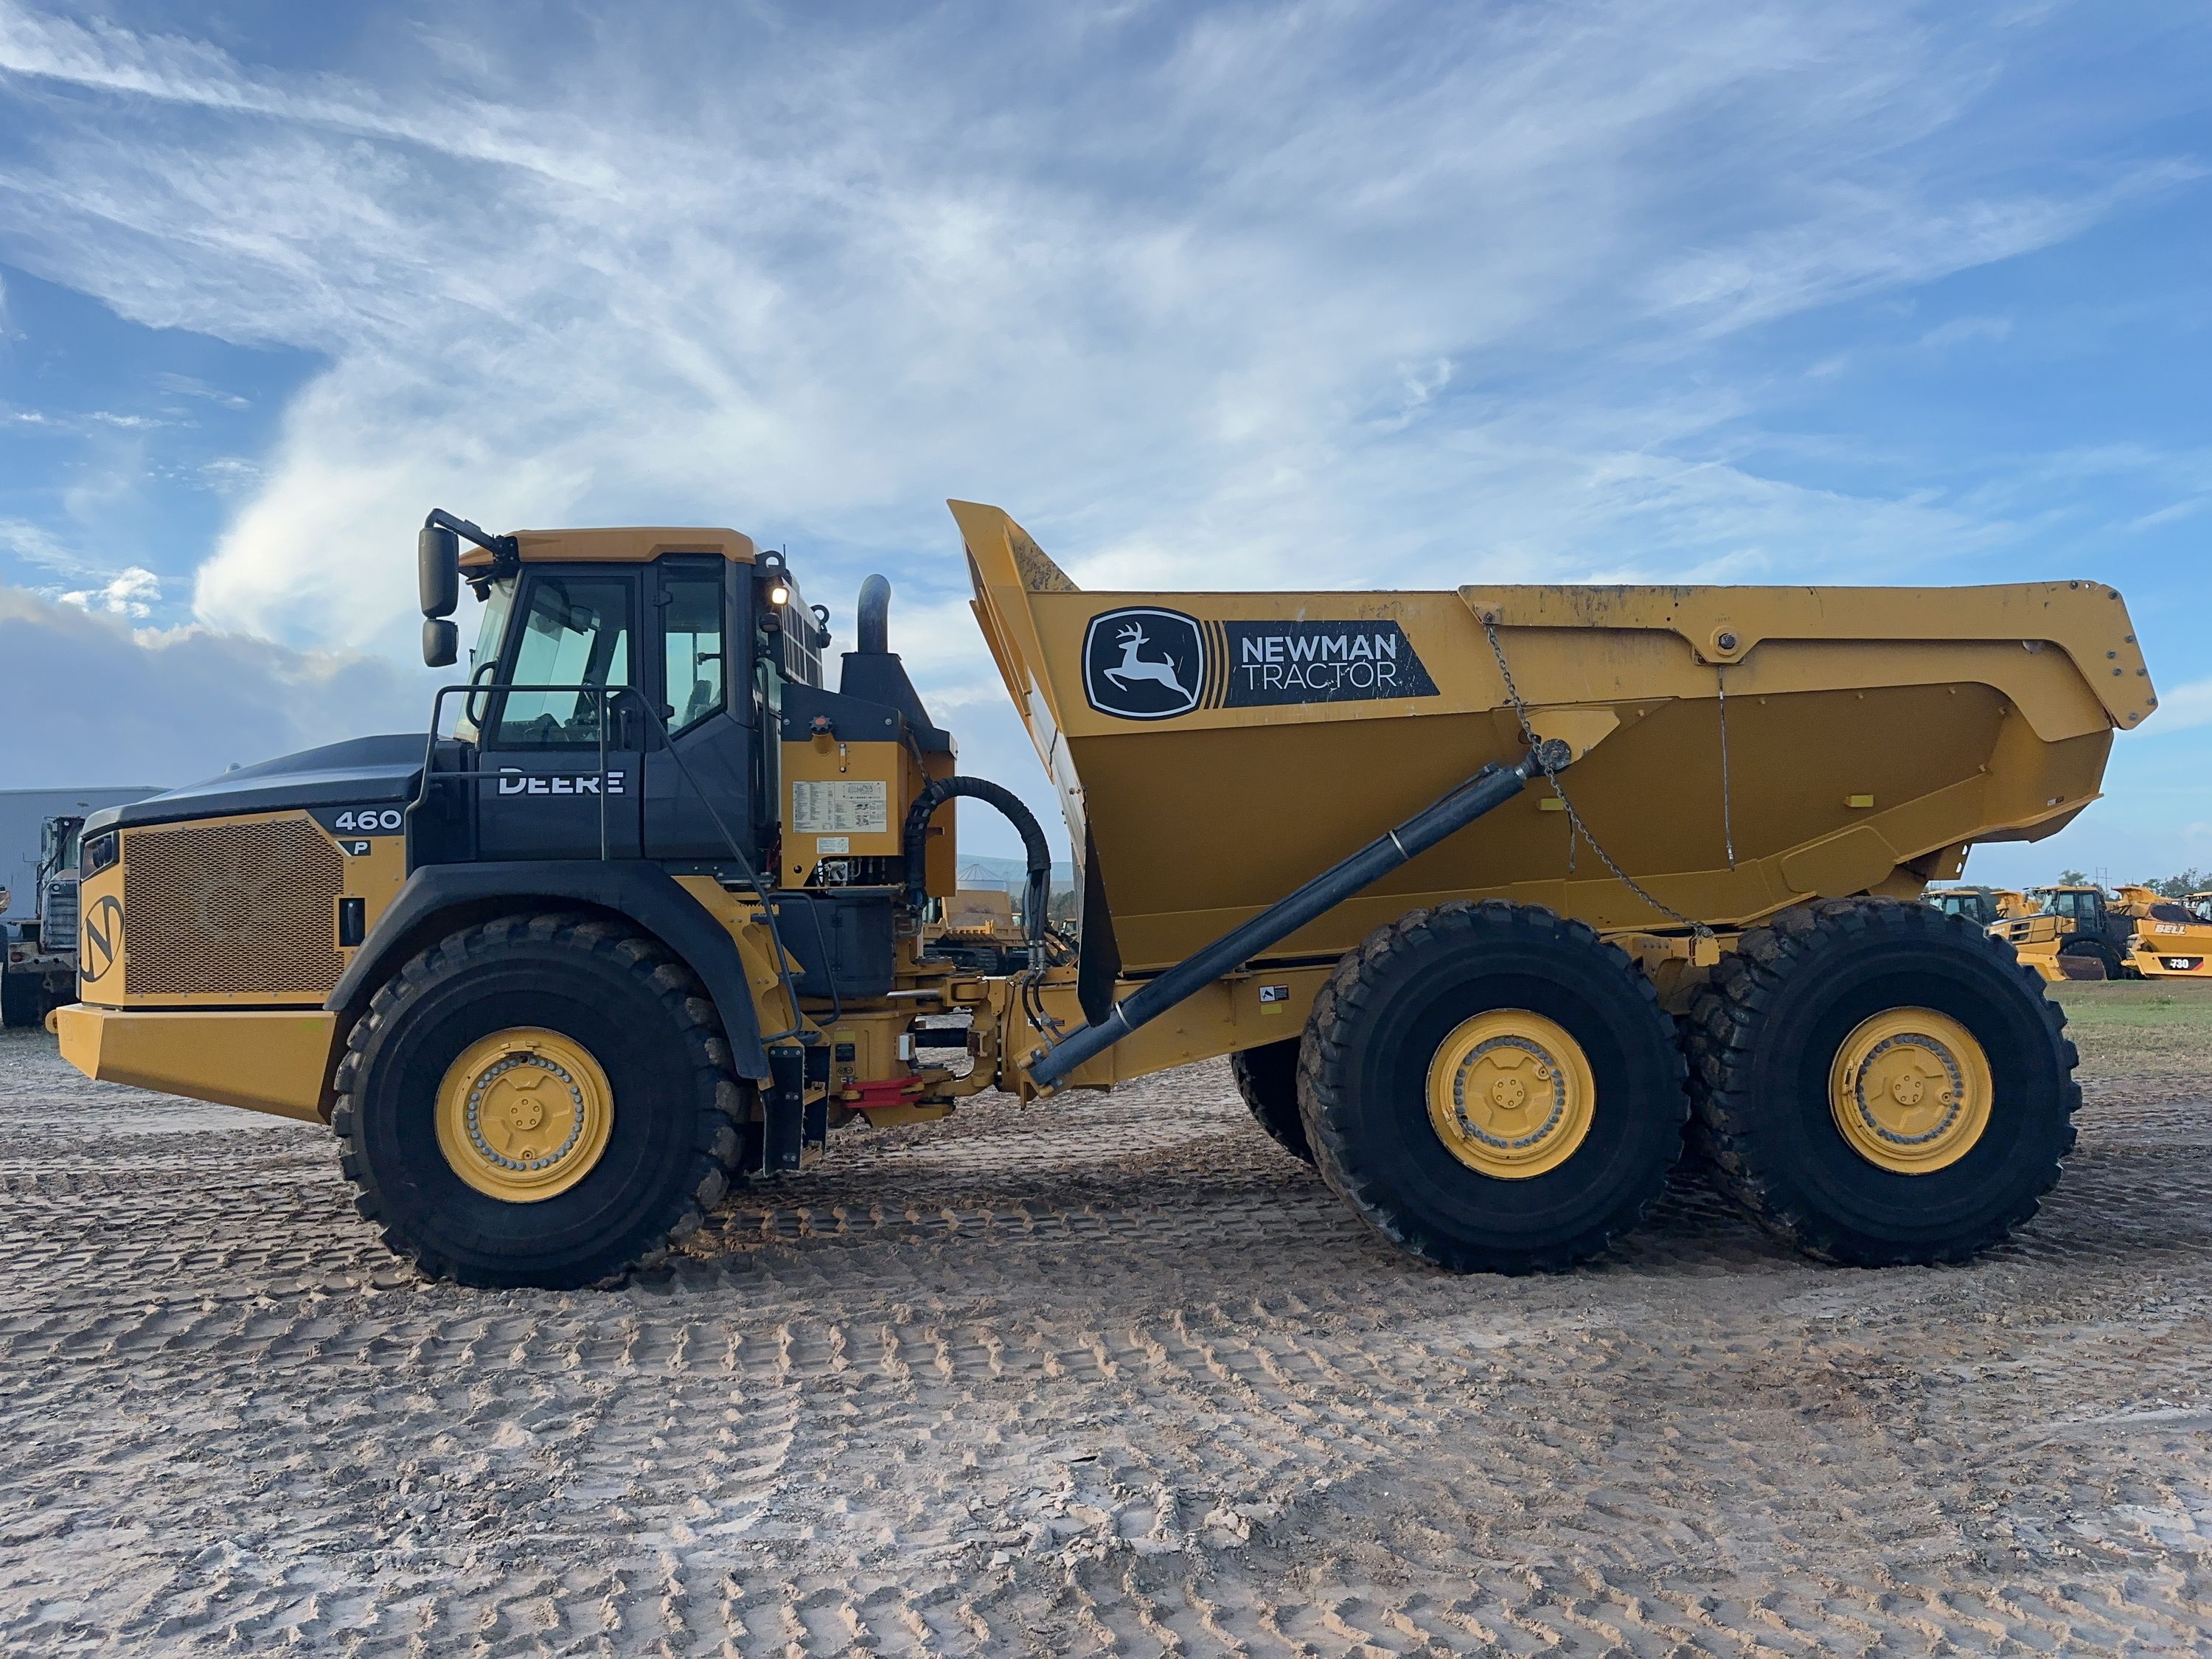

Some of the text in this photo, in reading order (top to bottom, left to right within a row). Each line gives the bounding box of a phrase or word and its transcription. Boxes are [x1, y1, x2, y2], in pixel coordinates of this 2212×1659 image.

[1242, 633, 1397, 663] NEWMAN
[1241, 661, 1397, 690] TRACTOR
[498, 768, 624, 794] DEERE
[335, 810, 402, 830] 460
[354, 841, 368, 855] P
[2154, 924, 2186, 935] BELL
[2170, 959, 2189, 969] 730
